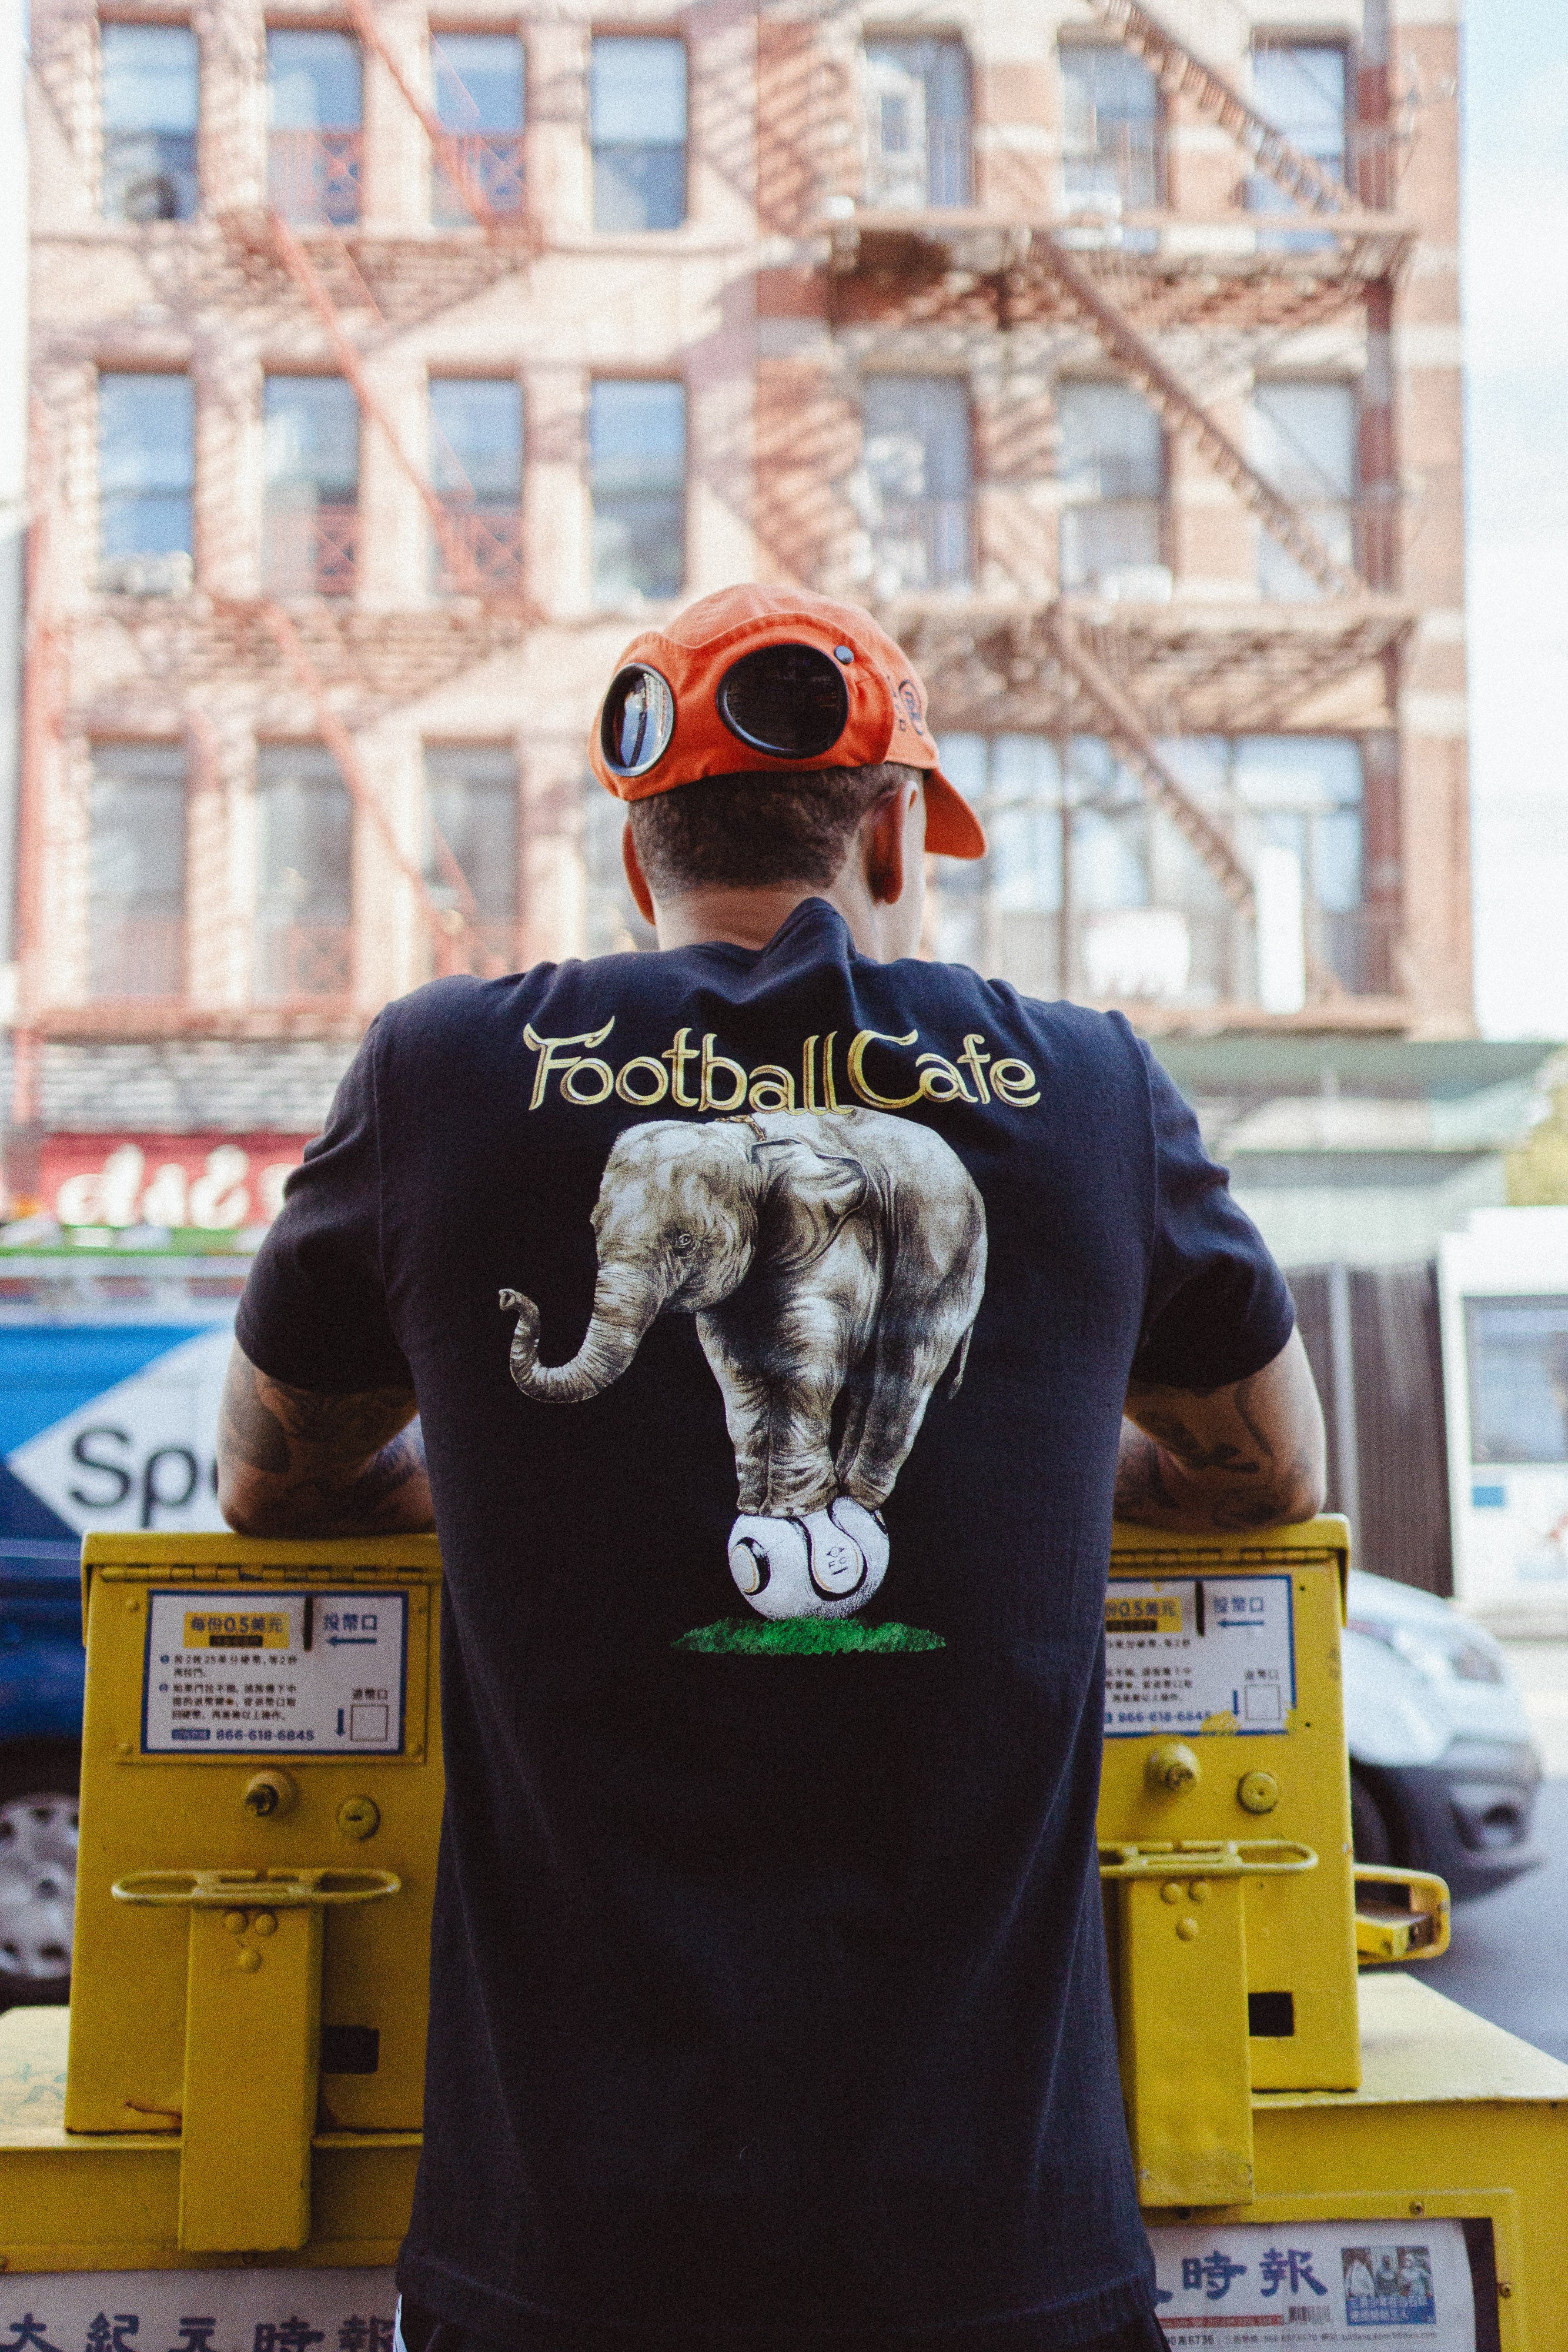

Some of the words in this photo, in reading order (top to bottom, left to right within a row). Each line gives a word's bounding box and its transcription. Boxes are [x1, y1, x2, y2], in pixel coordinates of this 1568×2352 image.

[523, 1015, 855, 1117] Football
[847, 1029, 1041, 1108] Cafe
[69, 1424, 218, 1528] Sp
[323, 1613, 378, 1632] 投幣口
[216, 1729, 315, 1741] 866-618-6845
[1154, 2247, 1329, 2302] 時報
